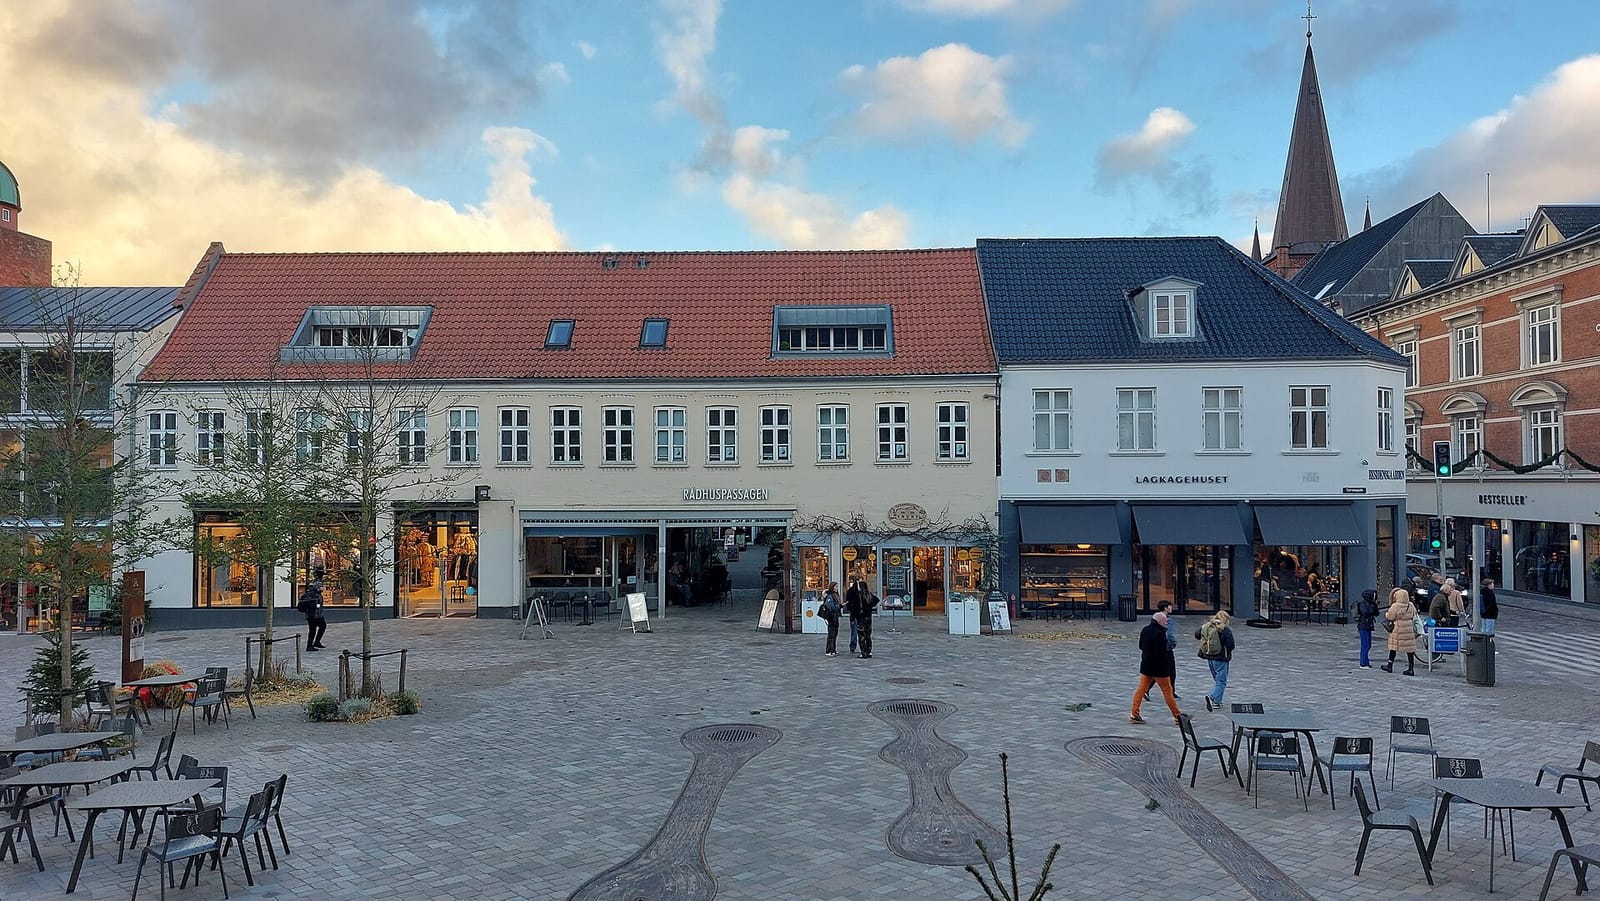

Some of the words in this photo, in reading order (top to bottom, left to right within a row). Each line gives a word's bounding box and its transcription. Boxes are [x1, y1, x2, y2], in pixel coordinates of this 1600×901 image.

[1136, 476, 1228, 484] LAGKAGEHUSET
[683, 487, 769, 500] RÅDHUSPASSAGEN
[1478, 494, 1526, 506] BESTSELLER
